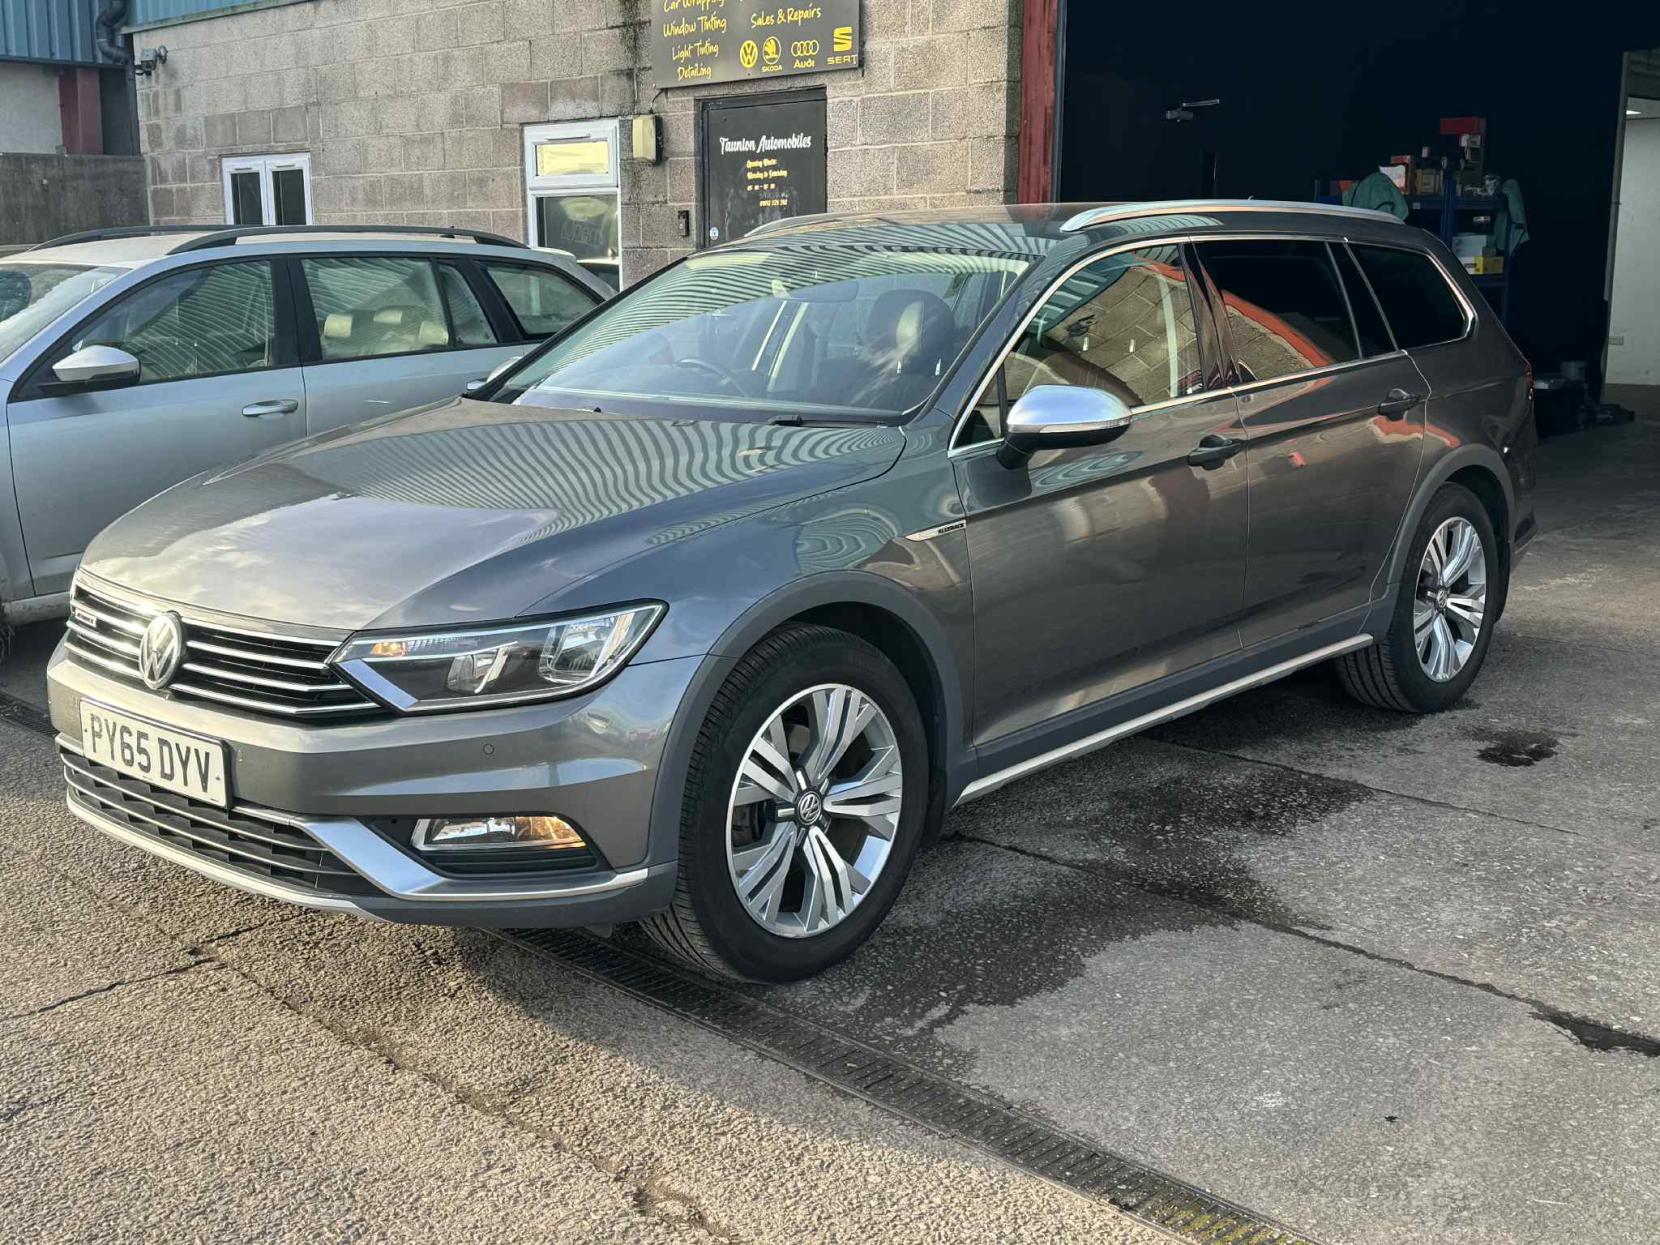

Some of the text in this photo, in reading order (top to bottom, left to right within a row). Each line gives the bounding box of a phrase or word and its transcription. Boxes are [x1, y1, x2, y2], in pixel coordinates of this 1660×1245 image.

[682, 0, 724, 11] Wrappg
[751, 3, 822, 28] Sales & Repairs
[663, 11, 727, 37] Window Tinting
[672, 38, 719, 63] Light Tinting
[827, 54, 858, 65] SEAT
[677, 63, 711, 81] Detailing
[793, 58, 815, 69] Audi
[719, 132, 812, 155] Taunton Automobiles
[90, 713, 210, 793] PY65 DYV
